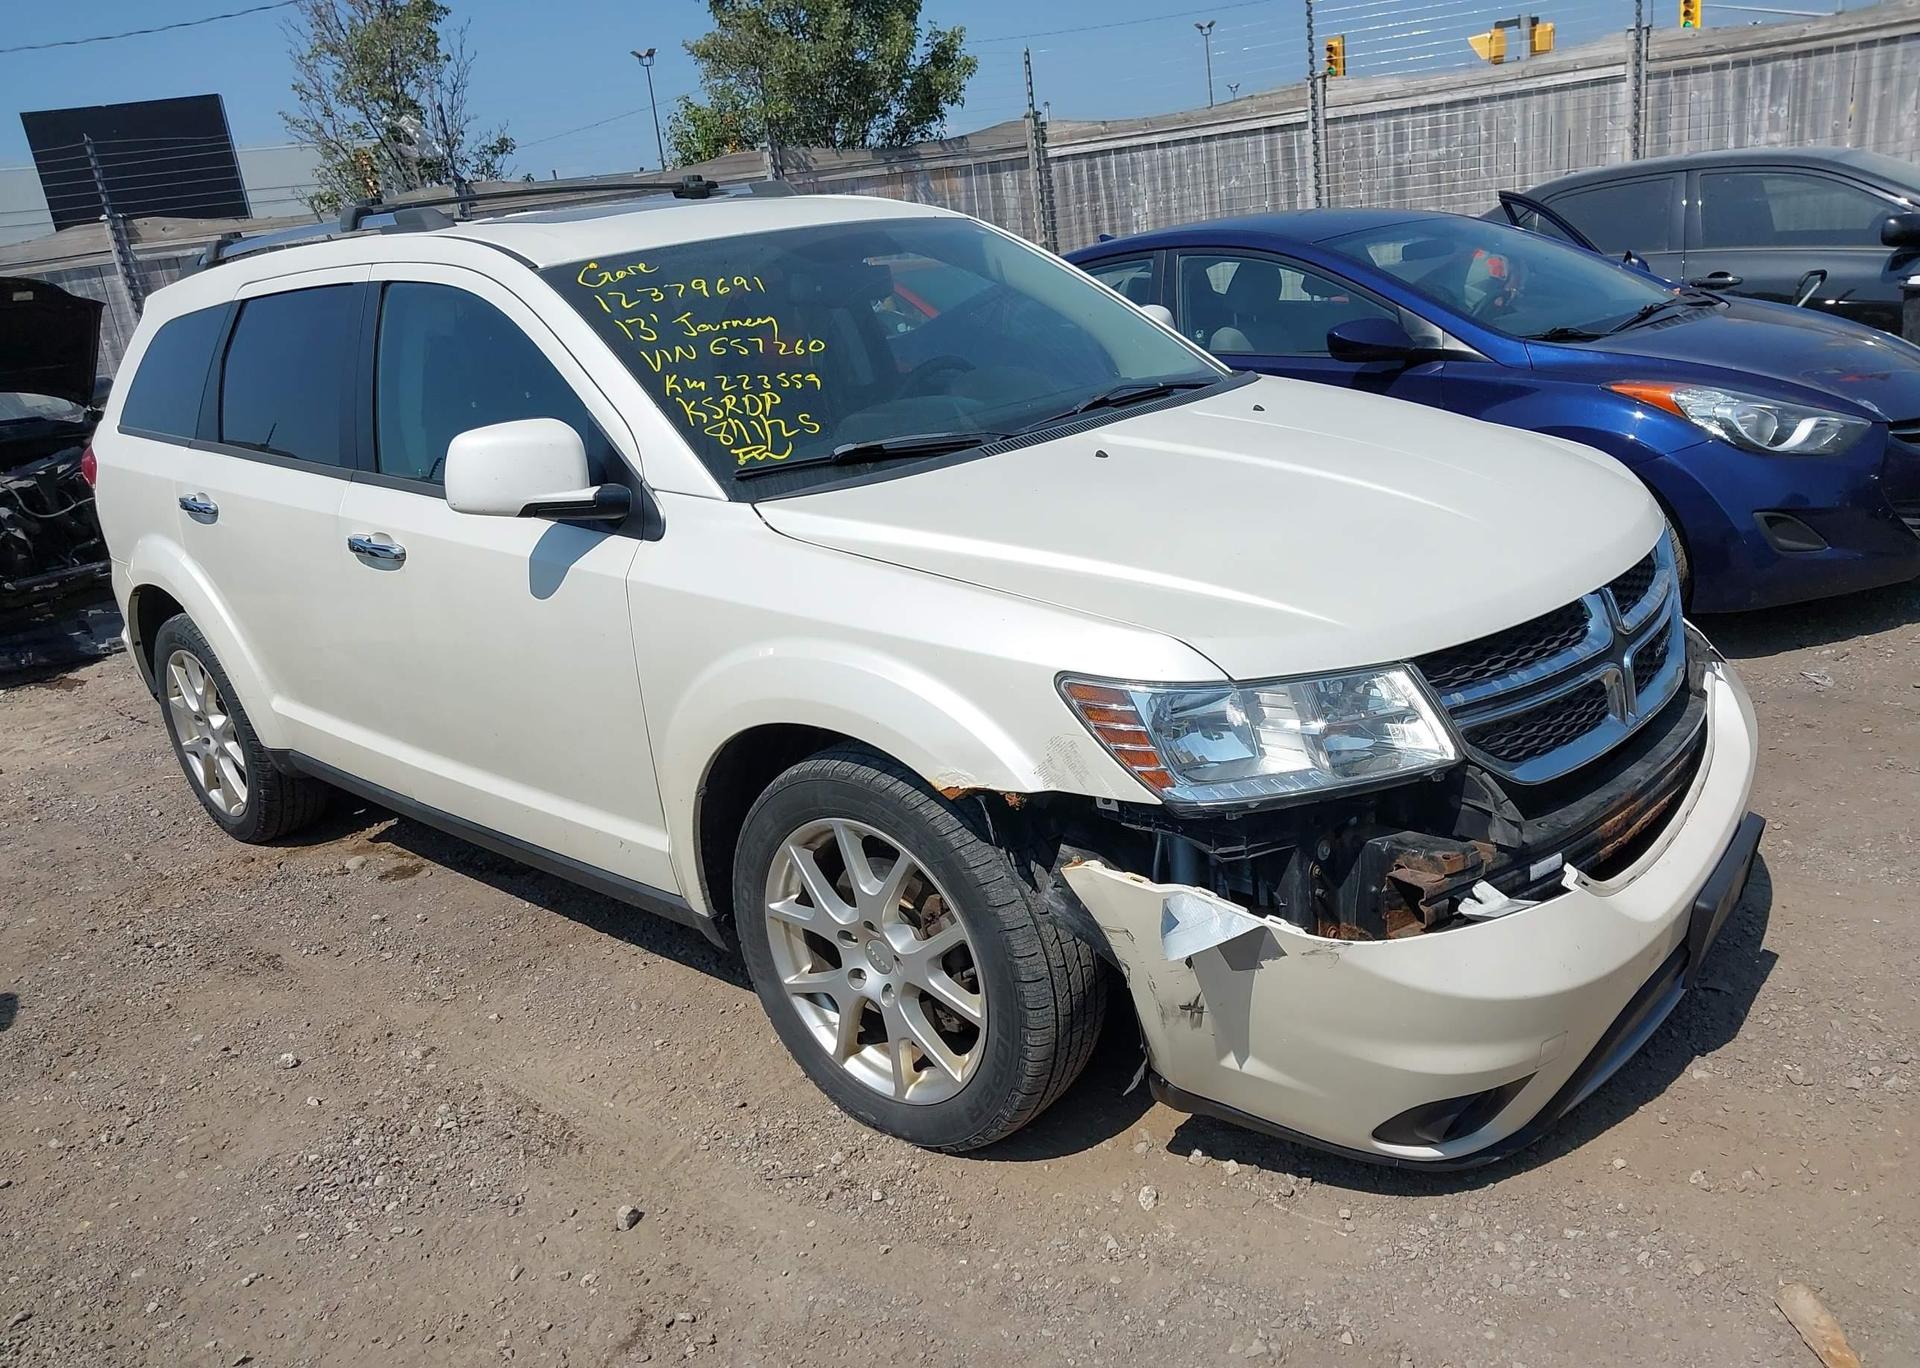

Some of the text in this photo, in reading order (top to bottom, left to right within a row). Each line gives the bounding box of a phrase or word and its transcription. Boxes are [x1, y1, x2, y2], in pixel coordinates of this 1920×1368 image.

[594, 276, 766, 312] 12379691
[672, 312, 779, 342] Journey
[640, 344, 697, 372] VIN
